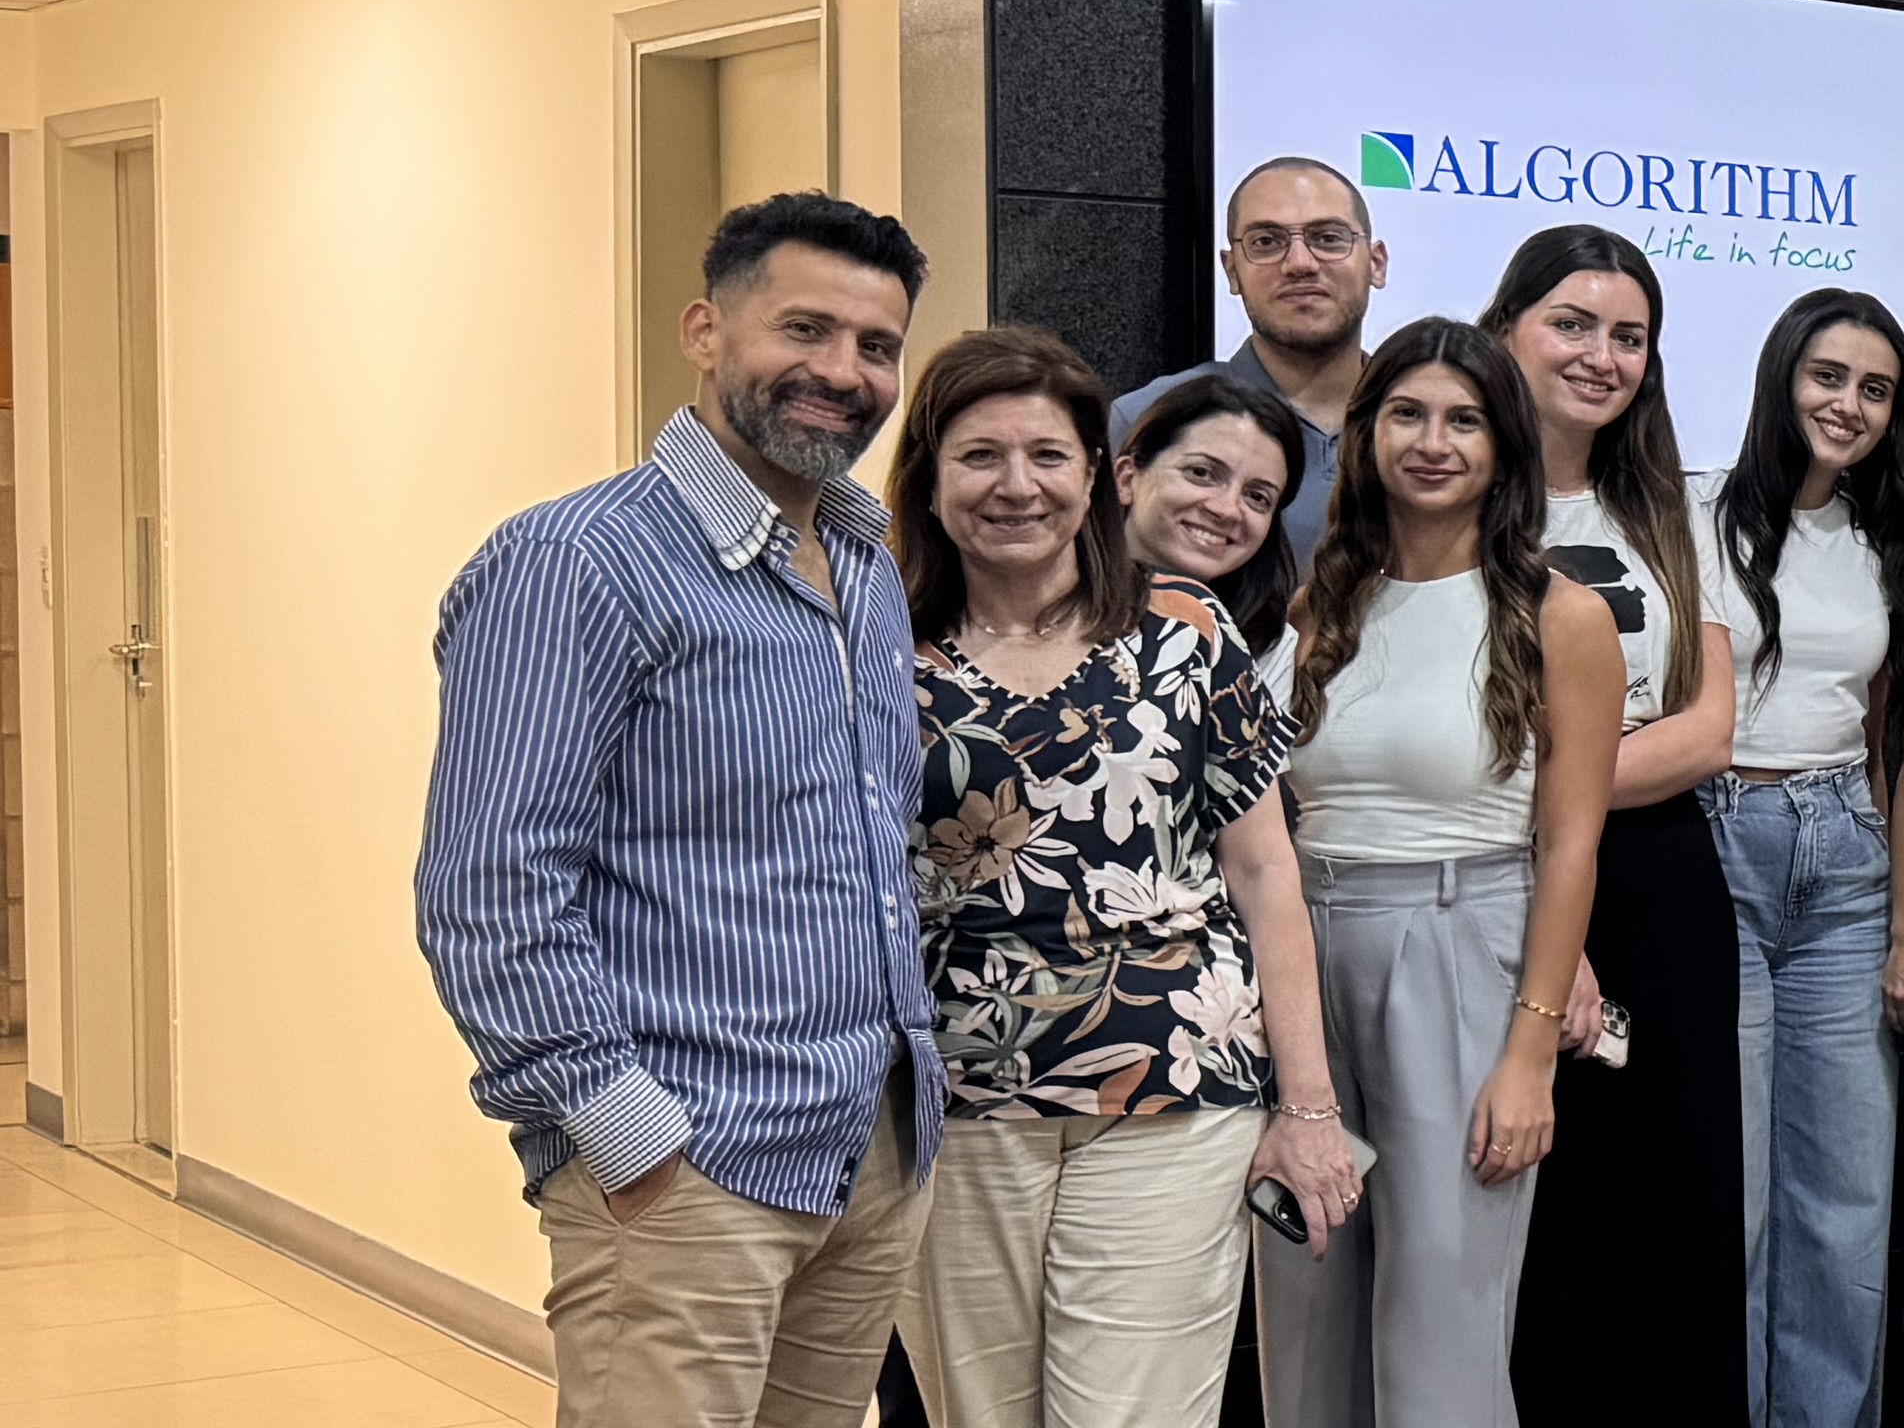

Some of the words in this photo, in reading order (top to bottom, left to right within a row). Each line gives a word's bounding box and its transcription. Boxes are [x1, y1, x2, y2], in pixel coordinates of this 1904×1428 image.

[1420, 135, 1859, 228] ALGORITHM
[1643, 224, 1714, 262] Life
[1729, 232, 1757, 265] in
[1768, 231, 1858, 272] focus
